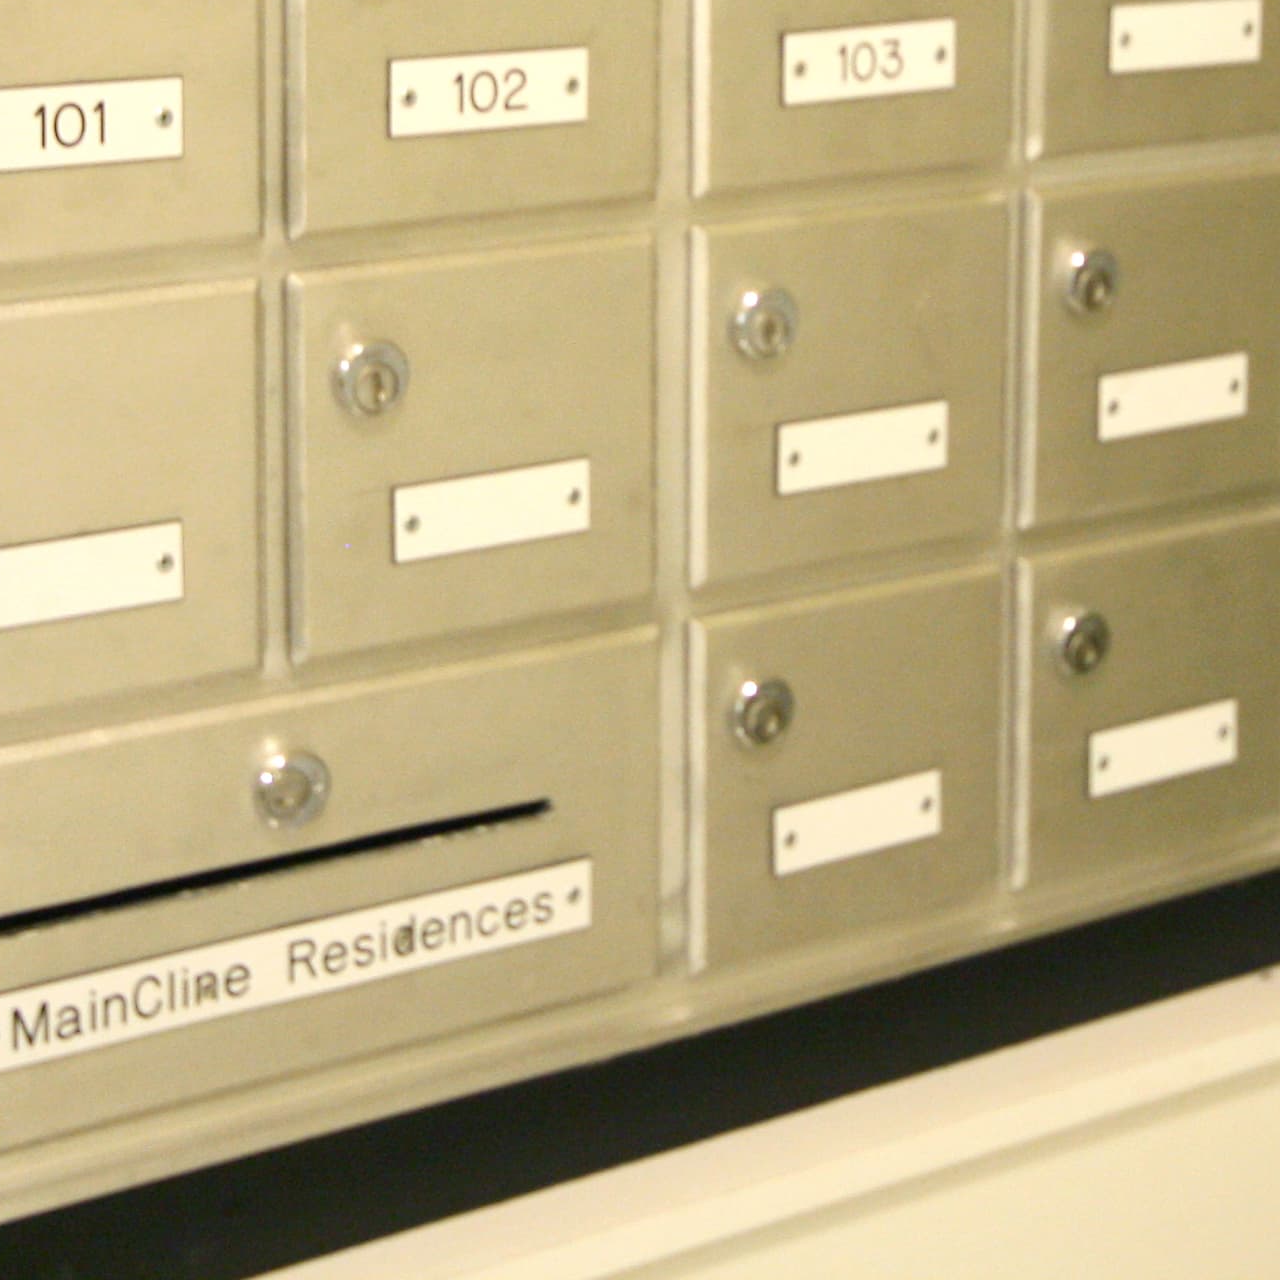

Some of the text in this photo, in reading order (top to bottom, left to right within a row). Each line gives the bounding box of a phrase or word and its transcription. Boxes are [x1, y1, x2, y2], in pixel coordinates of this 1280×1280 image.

[836, 37, 906, 84] 103
[452, 66, 530, 115] 102
[33, 99, 108, 151] 101
[287, 889, 555, 985] Residences
